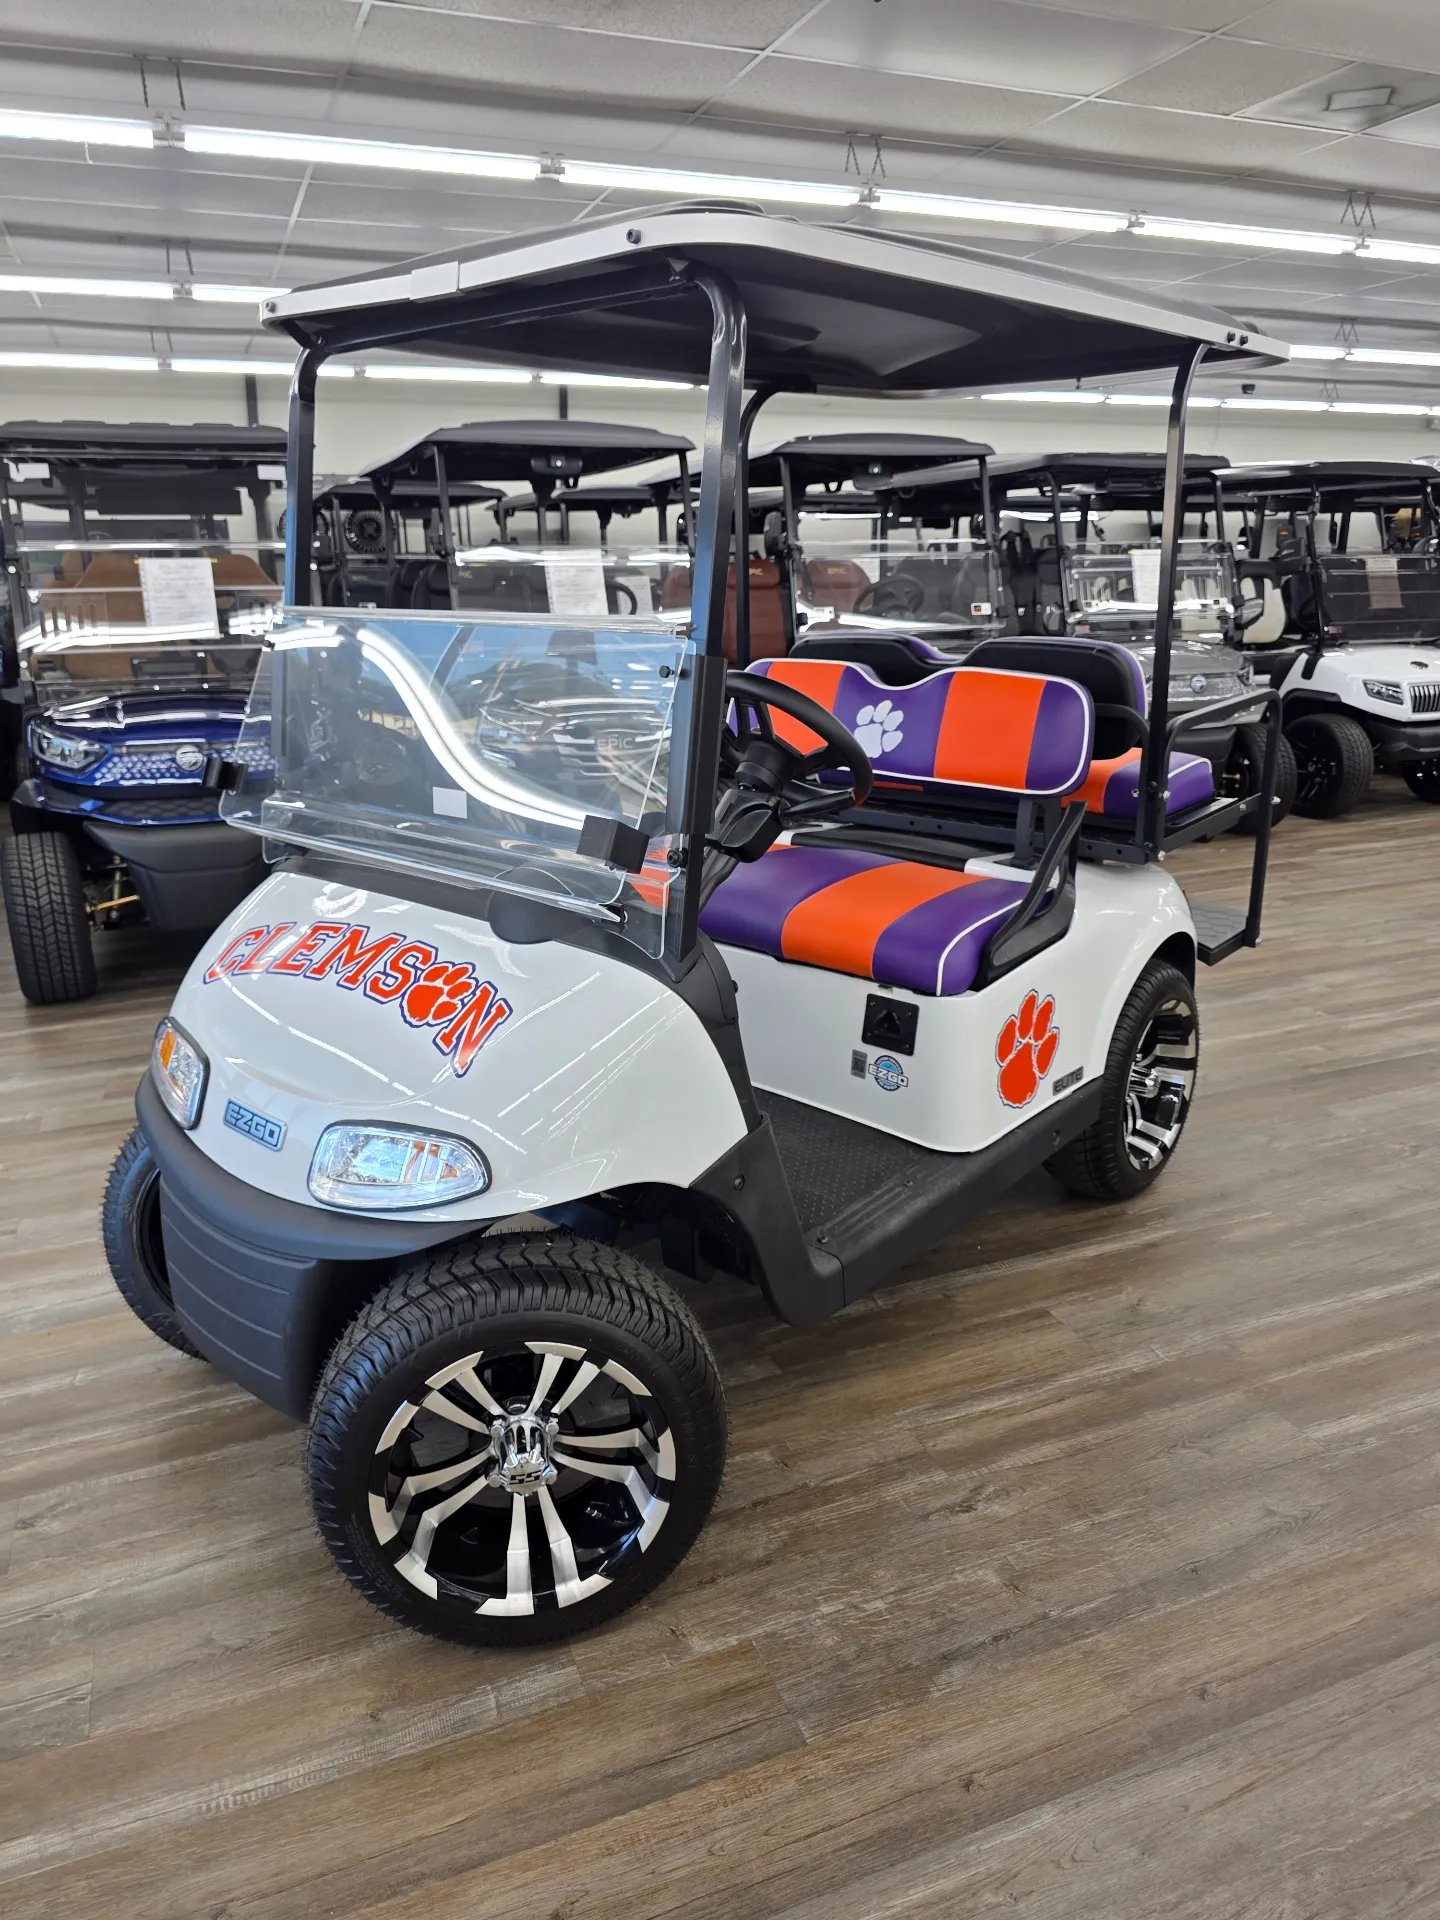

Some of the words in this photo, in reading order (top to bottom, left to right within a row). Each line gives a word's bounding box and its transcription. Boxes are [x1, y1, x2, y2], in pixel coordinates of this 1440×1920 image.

[596, 736, 633, 750] EPIC
[204, 921, 513, 1077] CLEMSON
[869, 1064, 908, 1087] EZGO
[225, 1102, 281, 1147] EZGO
